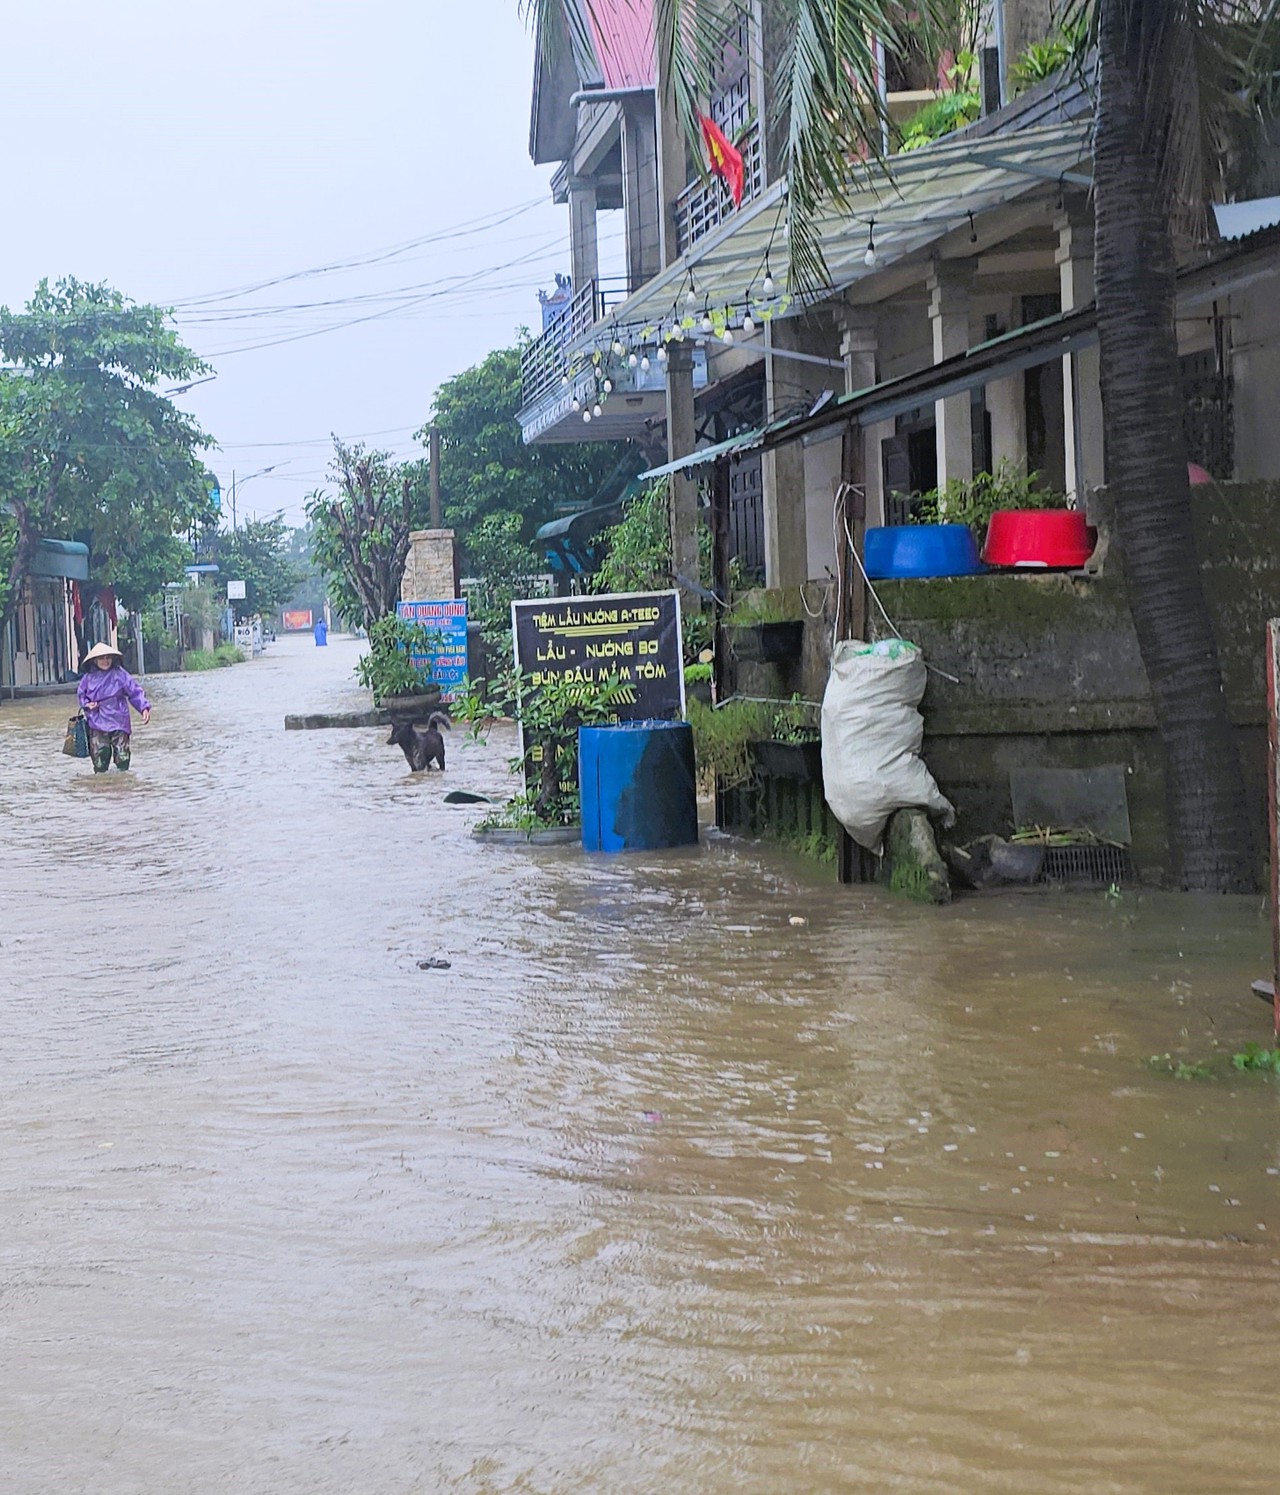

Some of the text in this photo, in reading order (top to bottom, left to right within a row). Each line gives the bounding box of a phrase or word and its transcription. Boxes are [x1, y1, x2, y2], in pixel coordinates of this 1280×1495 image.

[533, 611, 556, 629] TIỆM
[583, 608, 618, 625] NƯỚNG
[586, 640, 634, 658] NƯỚNG
[635, 661, 667, 679] TÔM
